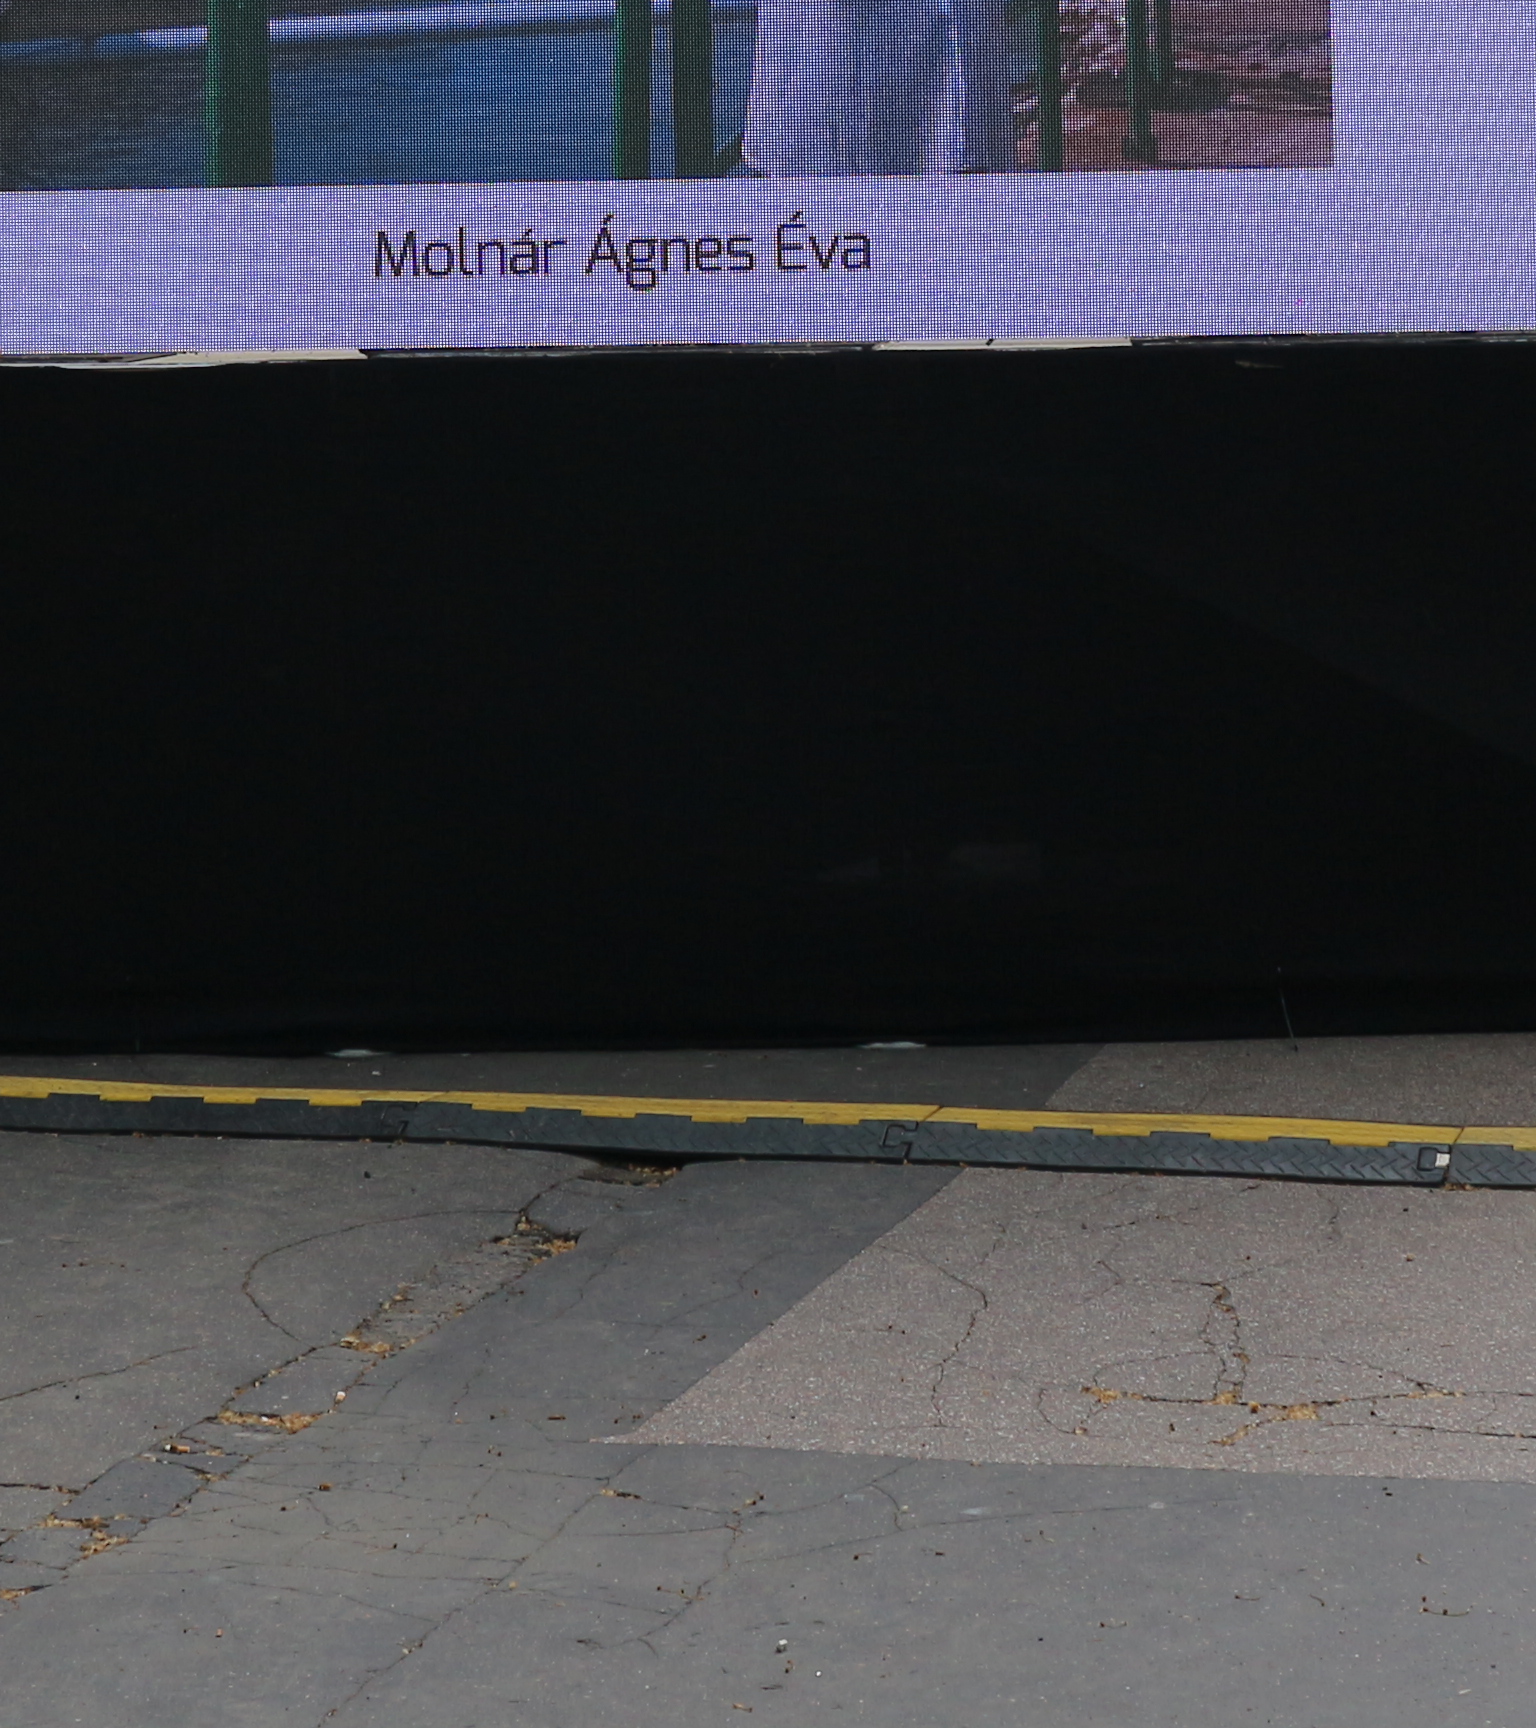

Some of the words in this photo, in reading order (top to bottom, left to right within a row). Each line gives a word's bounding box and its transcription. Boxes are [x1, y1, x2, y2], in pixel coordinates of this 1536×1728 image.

[373, 228, 566, 277] Molnár
[585, 214, 755, 291] Ágnes
[775, 211, 872, 271] Éva
